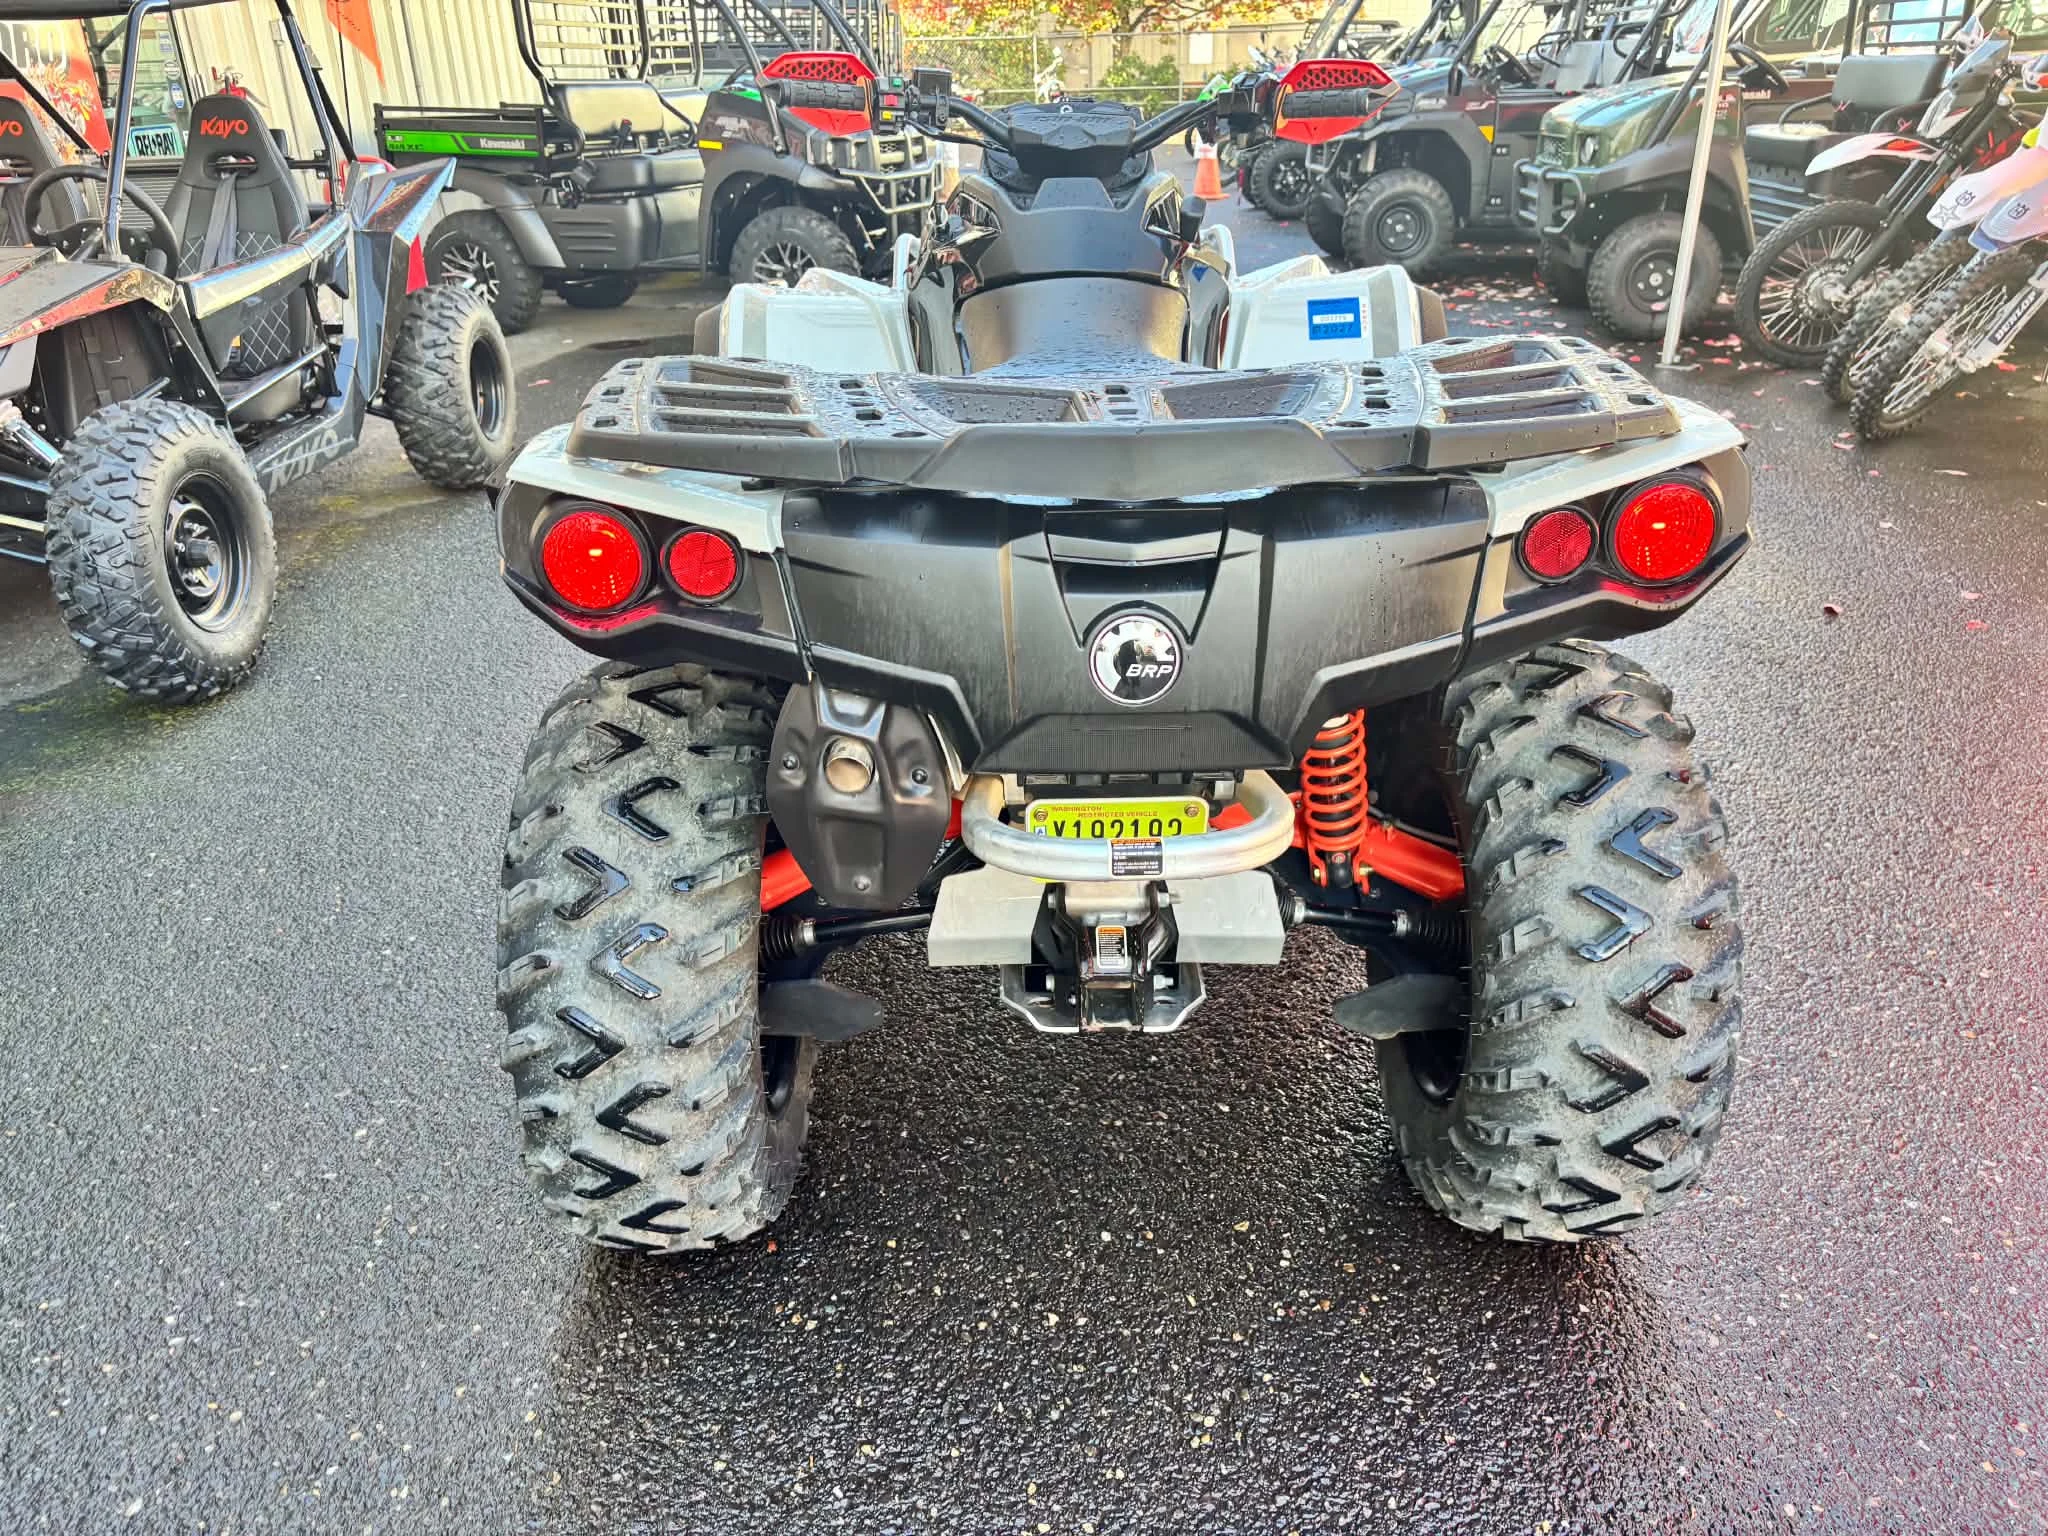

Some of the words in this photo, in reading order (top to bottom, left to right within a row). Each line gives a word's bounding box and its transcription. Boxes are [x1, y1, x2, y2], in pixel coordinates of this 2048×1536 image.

[200, 116, 249, 139] KAYO
[479, 138, 526, 150] Kawasaki
[1993, 290, 2037, 342] DUNLOP
[269, 429, 340, 495] KAYO
[1125, 663, 1174, 679] BRP
[1051, 805, 1102, 813] WASHINGTON
